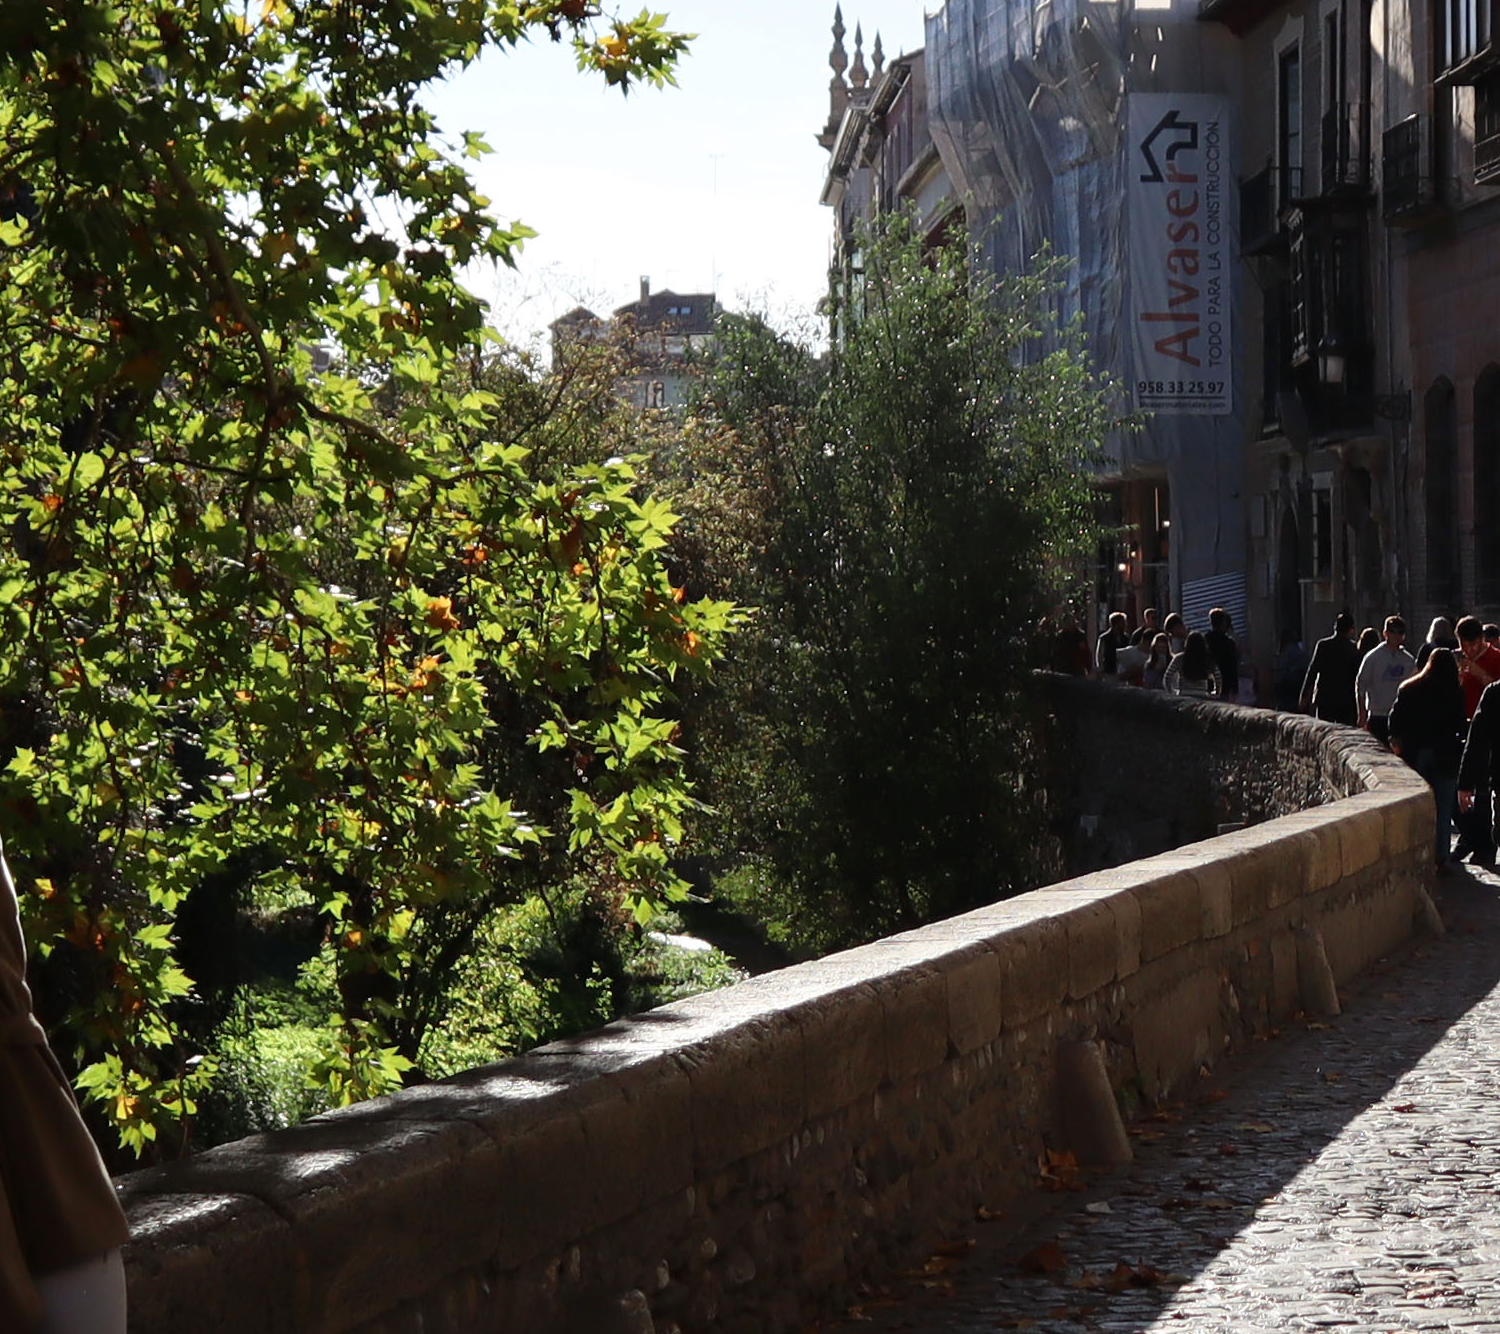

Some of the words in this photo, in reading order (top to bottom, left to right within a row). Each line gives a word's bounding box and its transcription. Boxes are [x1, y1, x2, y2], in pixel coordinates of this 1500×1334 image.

[1206, 122, 1220, 245] CONSTRUCCIÓN
[1140, 162, 1199, 366] Alvaser
[1207, 251, 1220, 270] LA
[1208, 276, 1220, 315] PARA
[1209, 321, 1221, 367] TODO
[1139, 381, 1225, 394] 958.33.25.97
